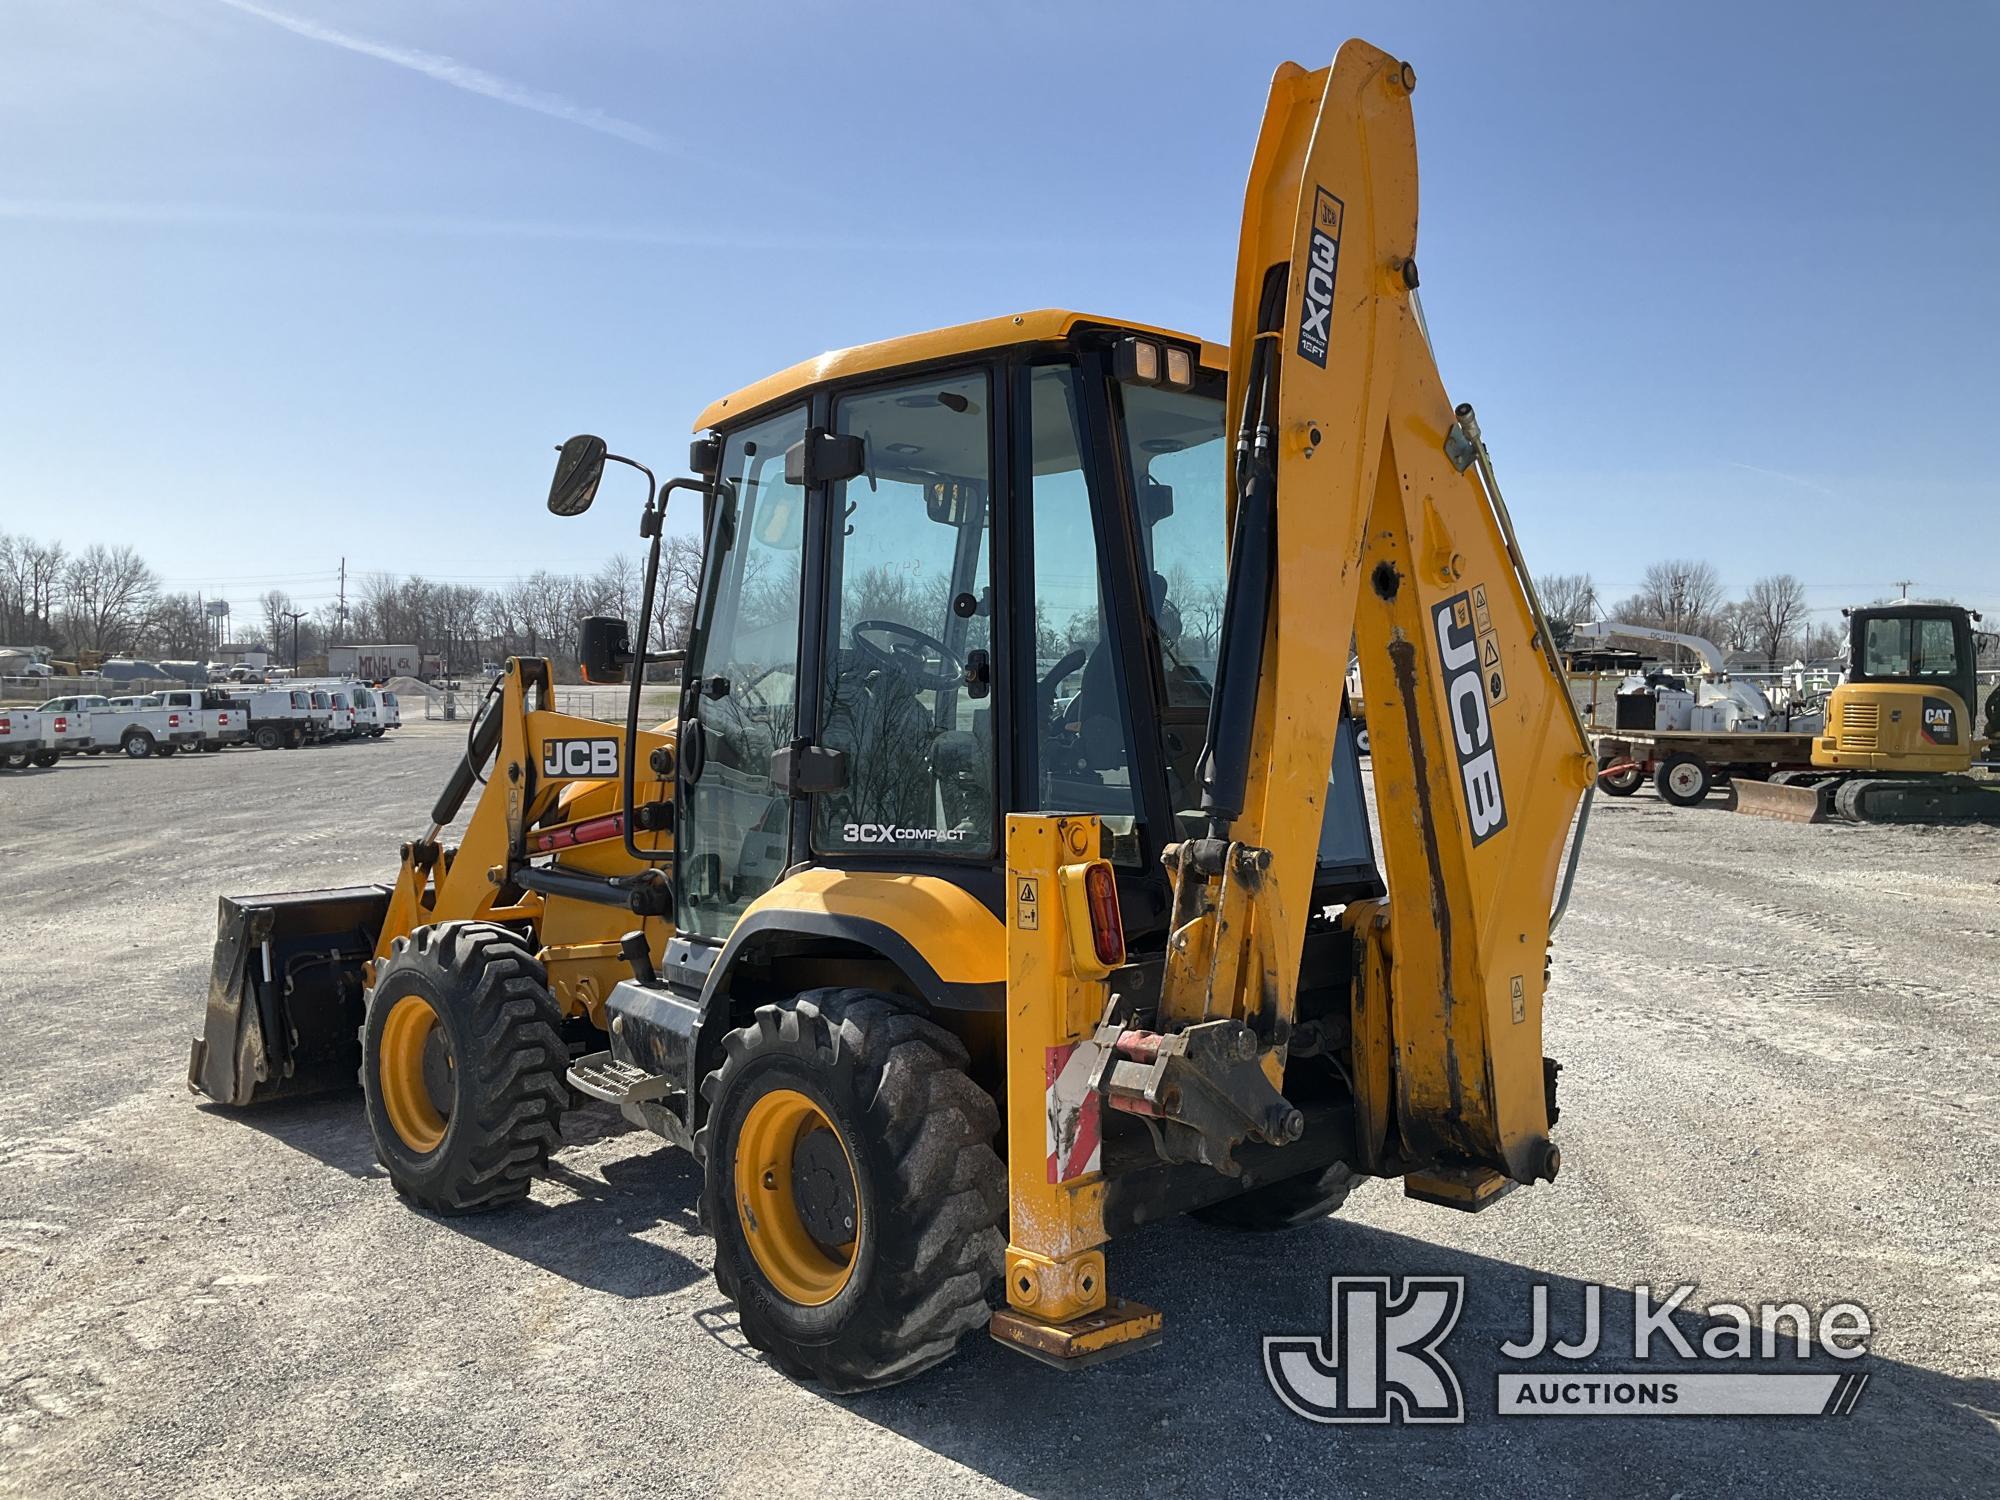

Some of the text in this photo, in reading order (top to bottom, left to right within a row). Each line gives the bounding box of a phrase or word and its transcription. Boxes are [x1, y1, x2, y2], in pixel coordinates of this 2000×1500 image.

[1302, 233, 1336, 341] 3CX
[1438, 606, 1502, 837] JCB
[1925, 709, 1952, 724] CAT
[544, 741, 618, 775] JCB
[843, 824, 966, 842] 3CX COMPACT
